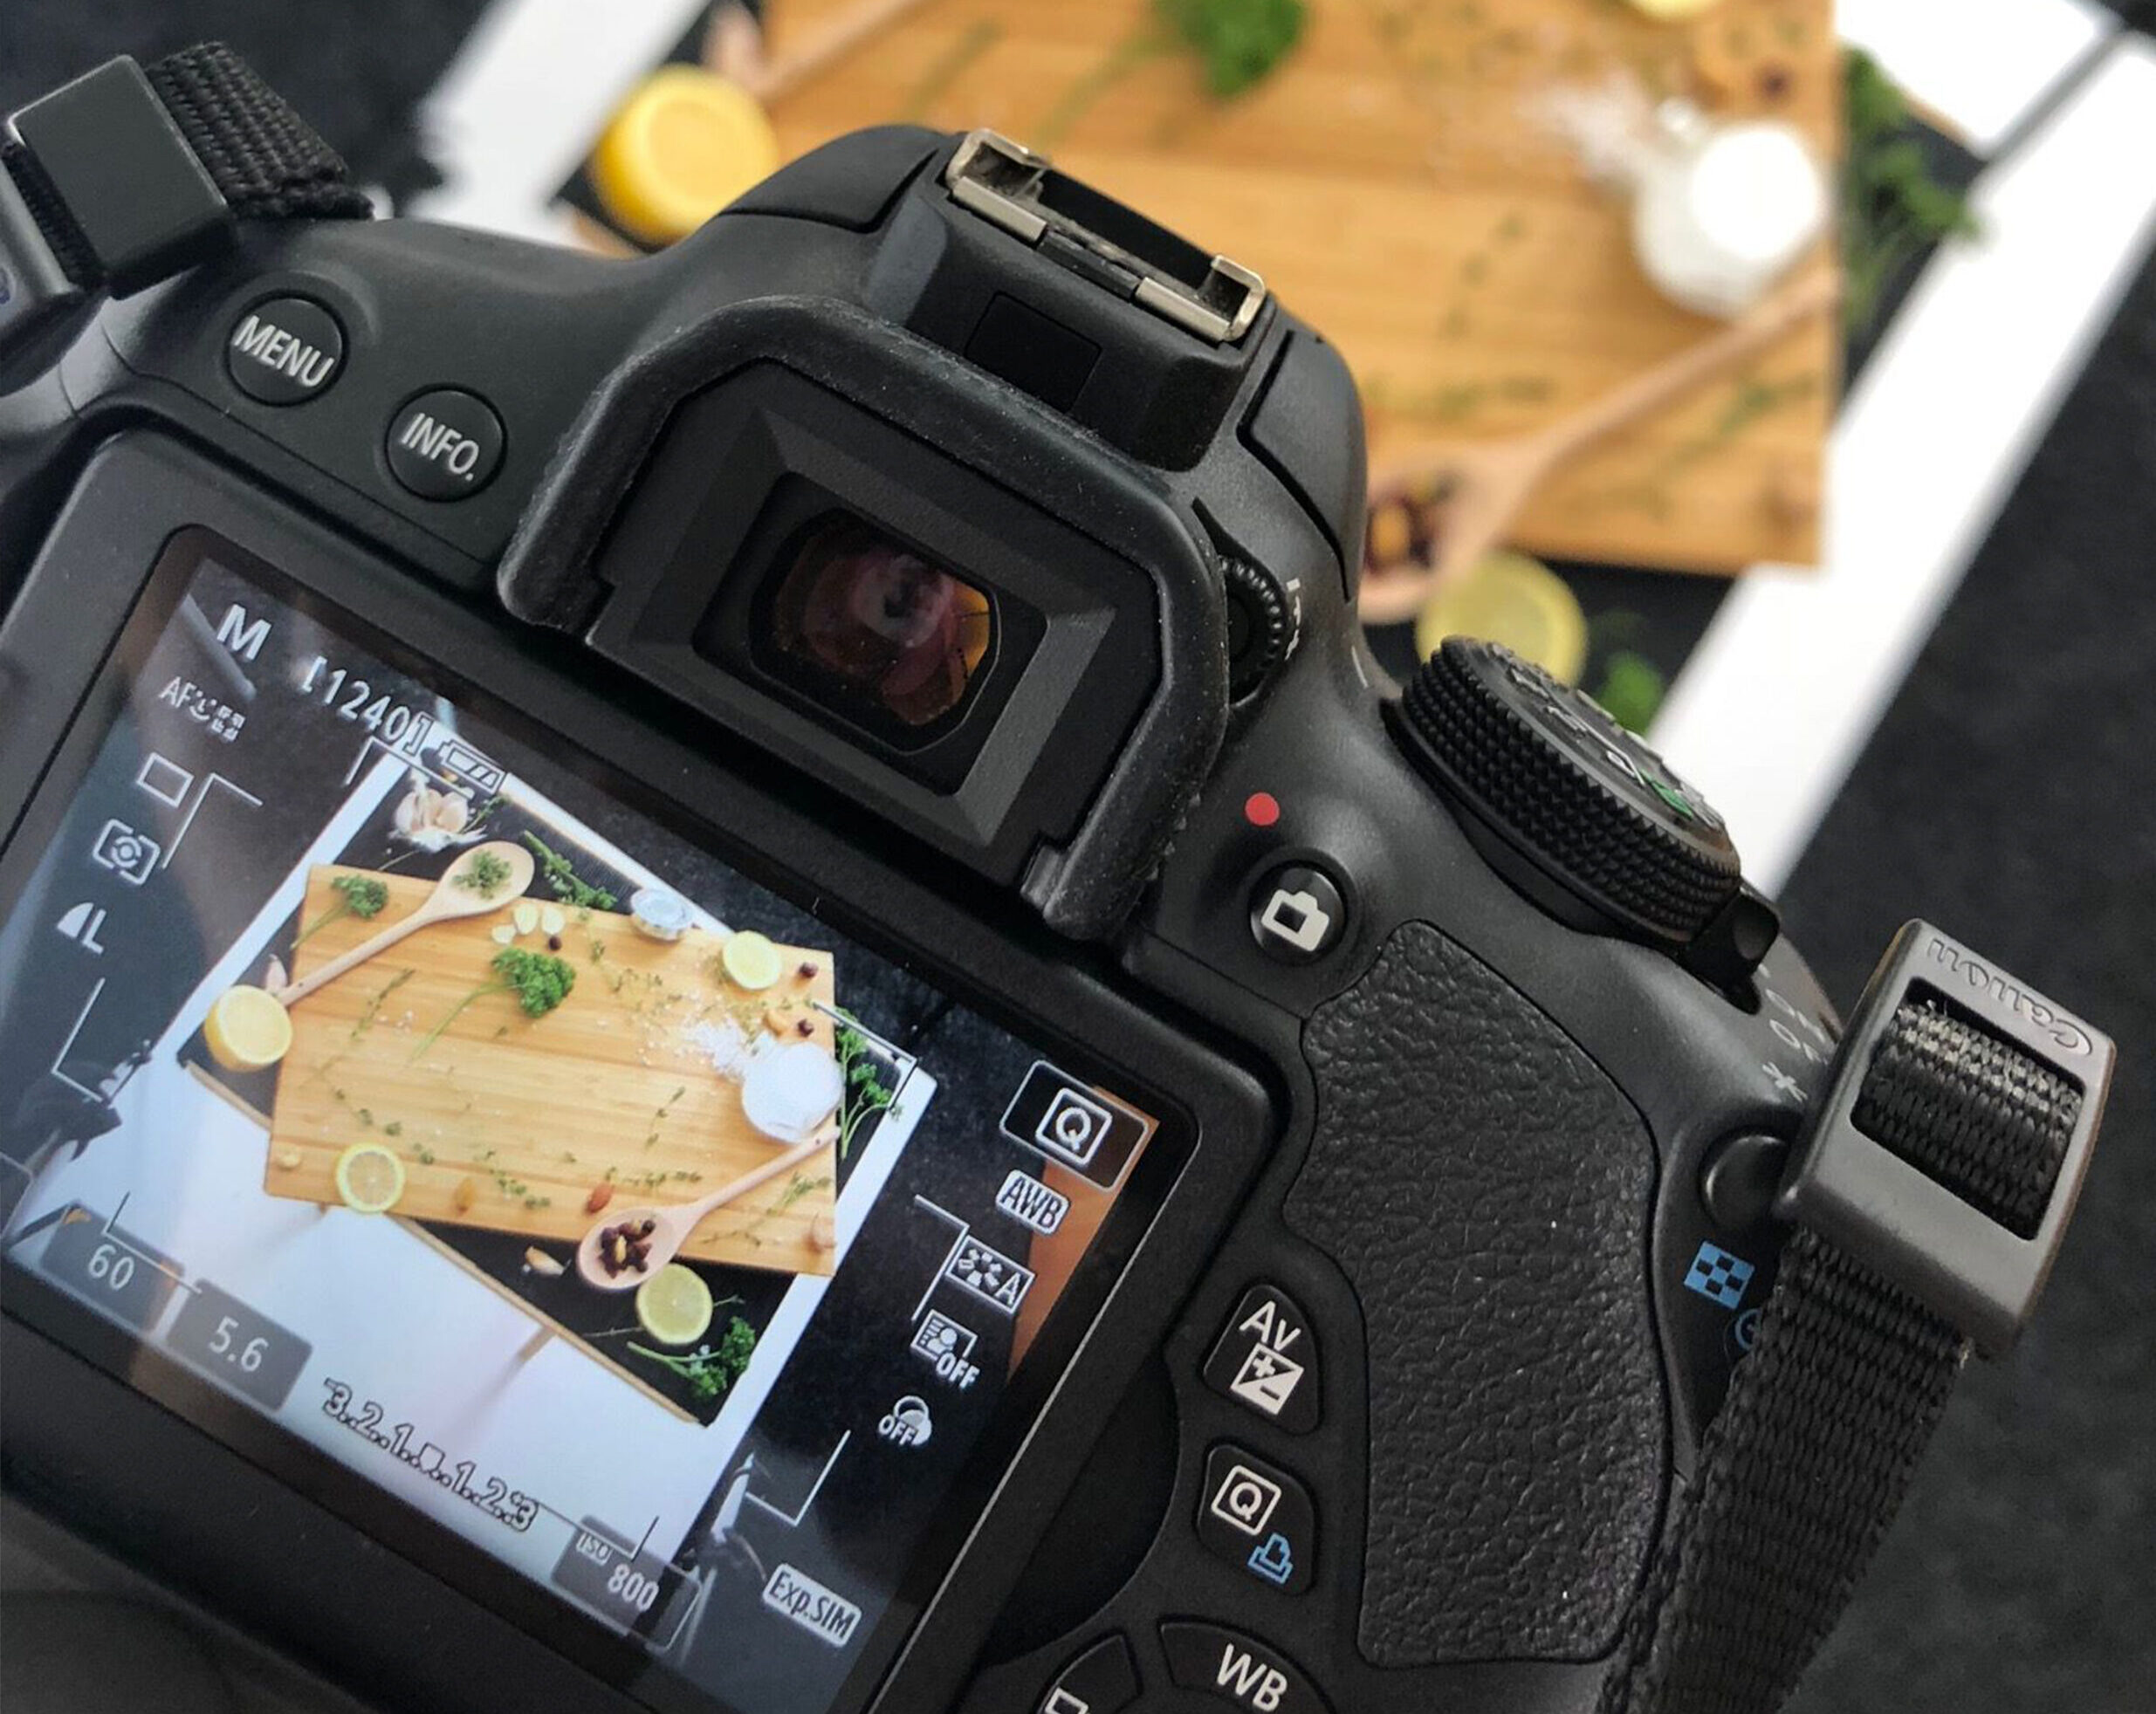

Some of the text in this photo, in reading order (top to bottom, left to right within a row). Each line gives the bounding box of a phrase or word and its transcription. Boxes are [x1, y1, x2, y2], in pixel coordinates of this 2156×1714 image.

[233, 314, 335, 387] MENU
[400, 412, 480, 481] INFO.
[216, 603, 272, 661] M
[1926, 936, 2093, 1056] Canon
[999, 1176, 1063, 1229] AWB
[88, 1243, 135, 1291] 60
[208, 1315, 270, 1373] 5.6
[936, 1351, 981, 1389] OFF
[877, 1413, 917, 1446] OFF
[1229, 1482, 1263, 1521] Q
[576, 1531, 615, 1567] ISO
[608, 1563, 660, 1613] 800
[769, 1571, 856, 1639] Exp.SIM
[1217, 1642, 1288, 1712] WB
